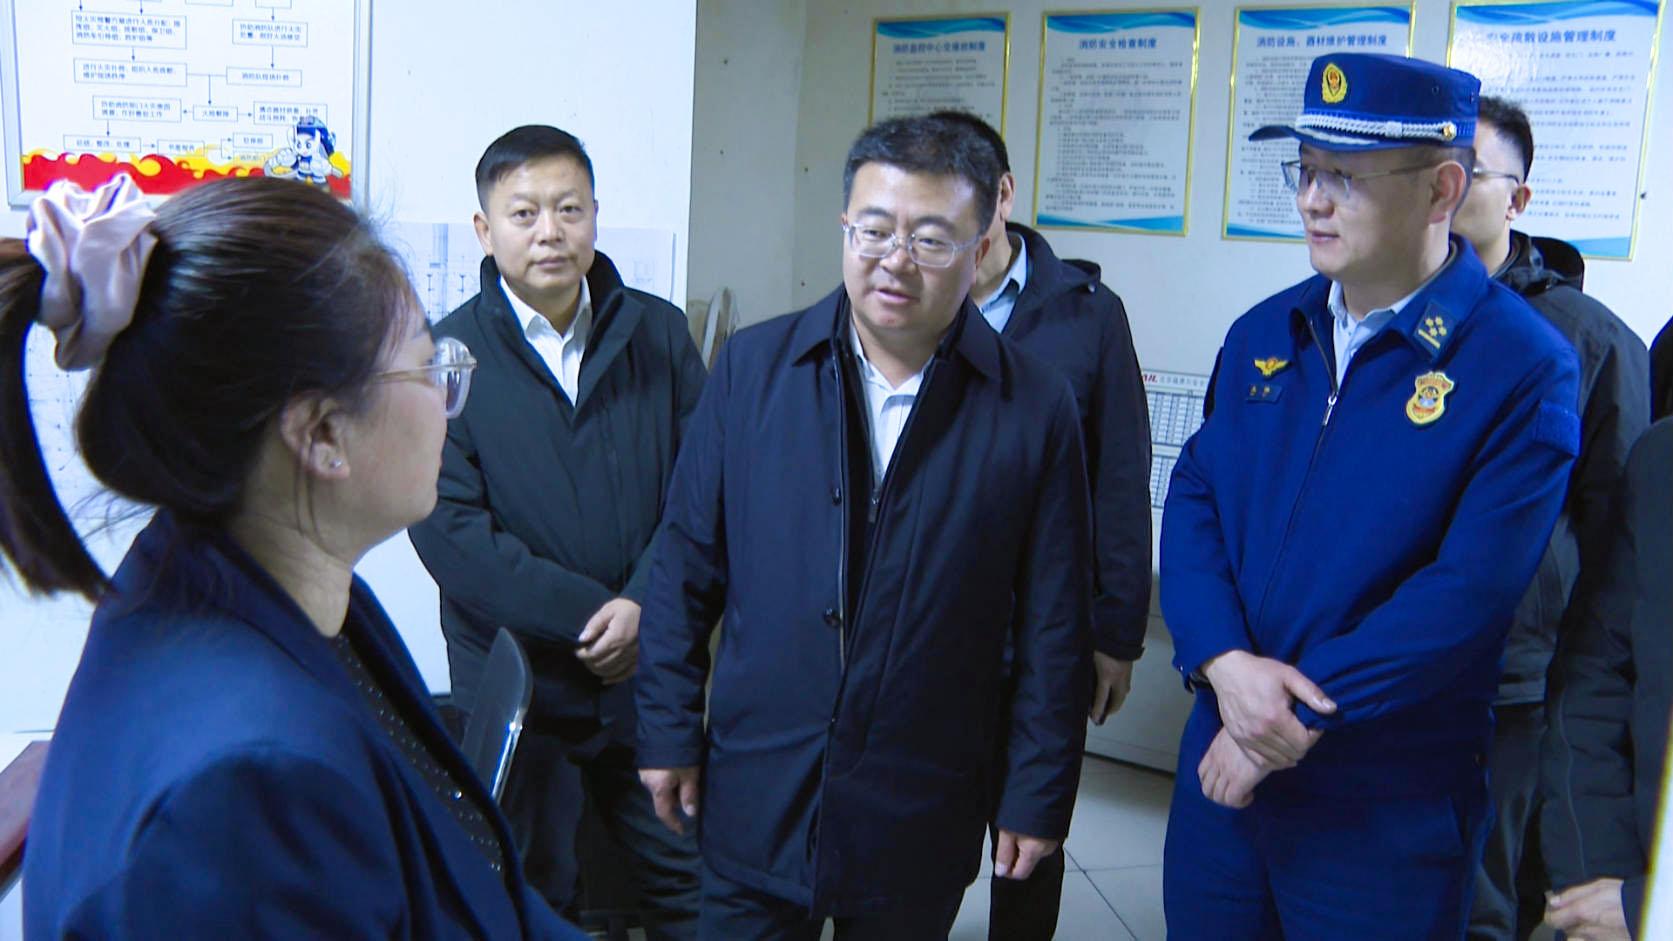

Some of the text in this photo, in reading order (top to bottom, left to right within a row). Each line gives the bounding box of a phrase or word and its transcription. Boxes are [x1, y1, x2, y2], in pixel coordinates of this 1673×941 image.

[1080, 38, 1157, 49] 消防安全检查制度
[1256, 35, 1387, 48] 消防设施、器材维护管理制度
